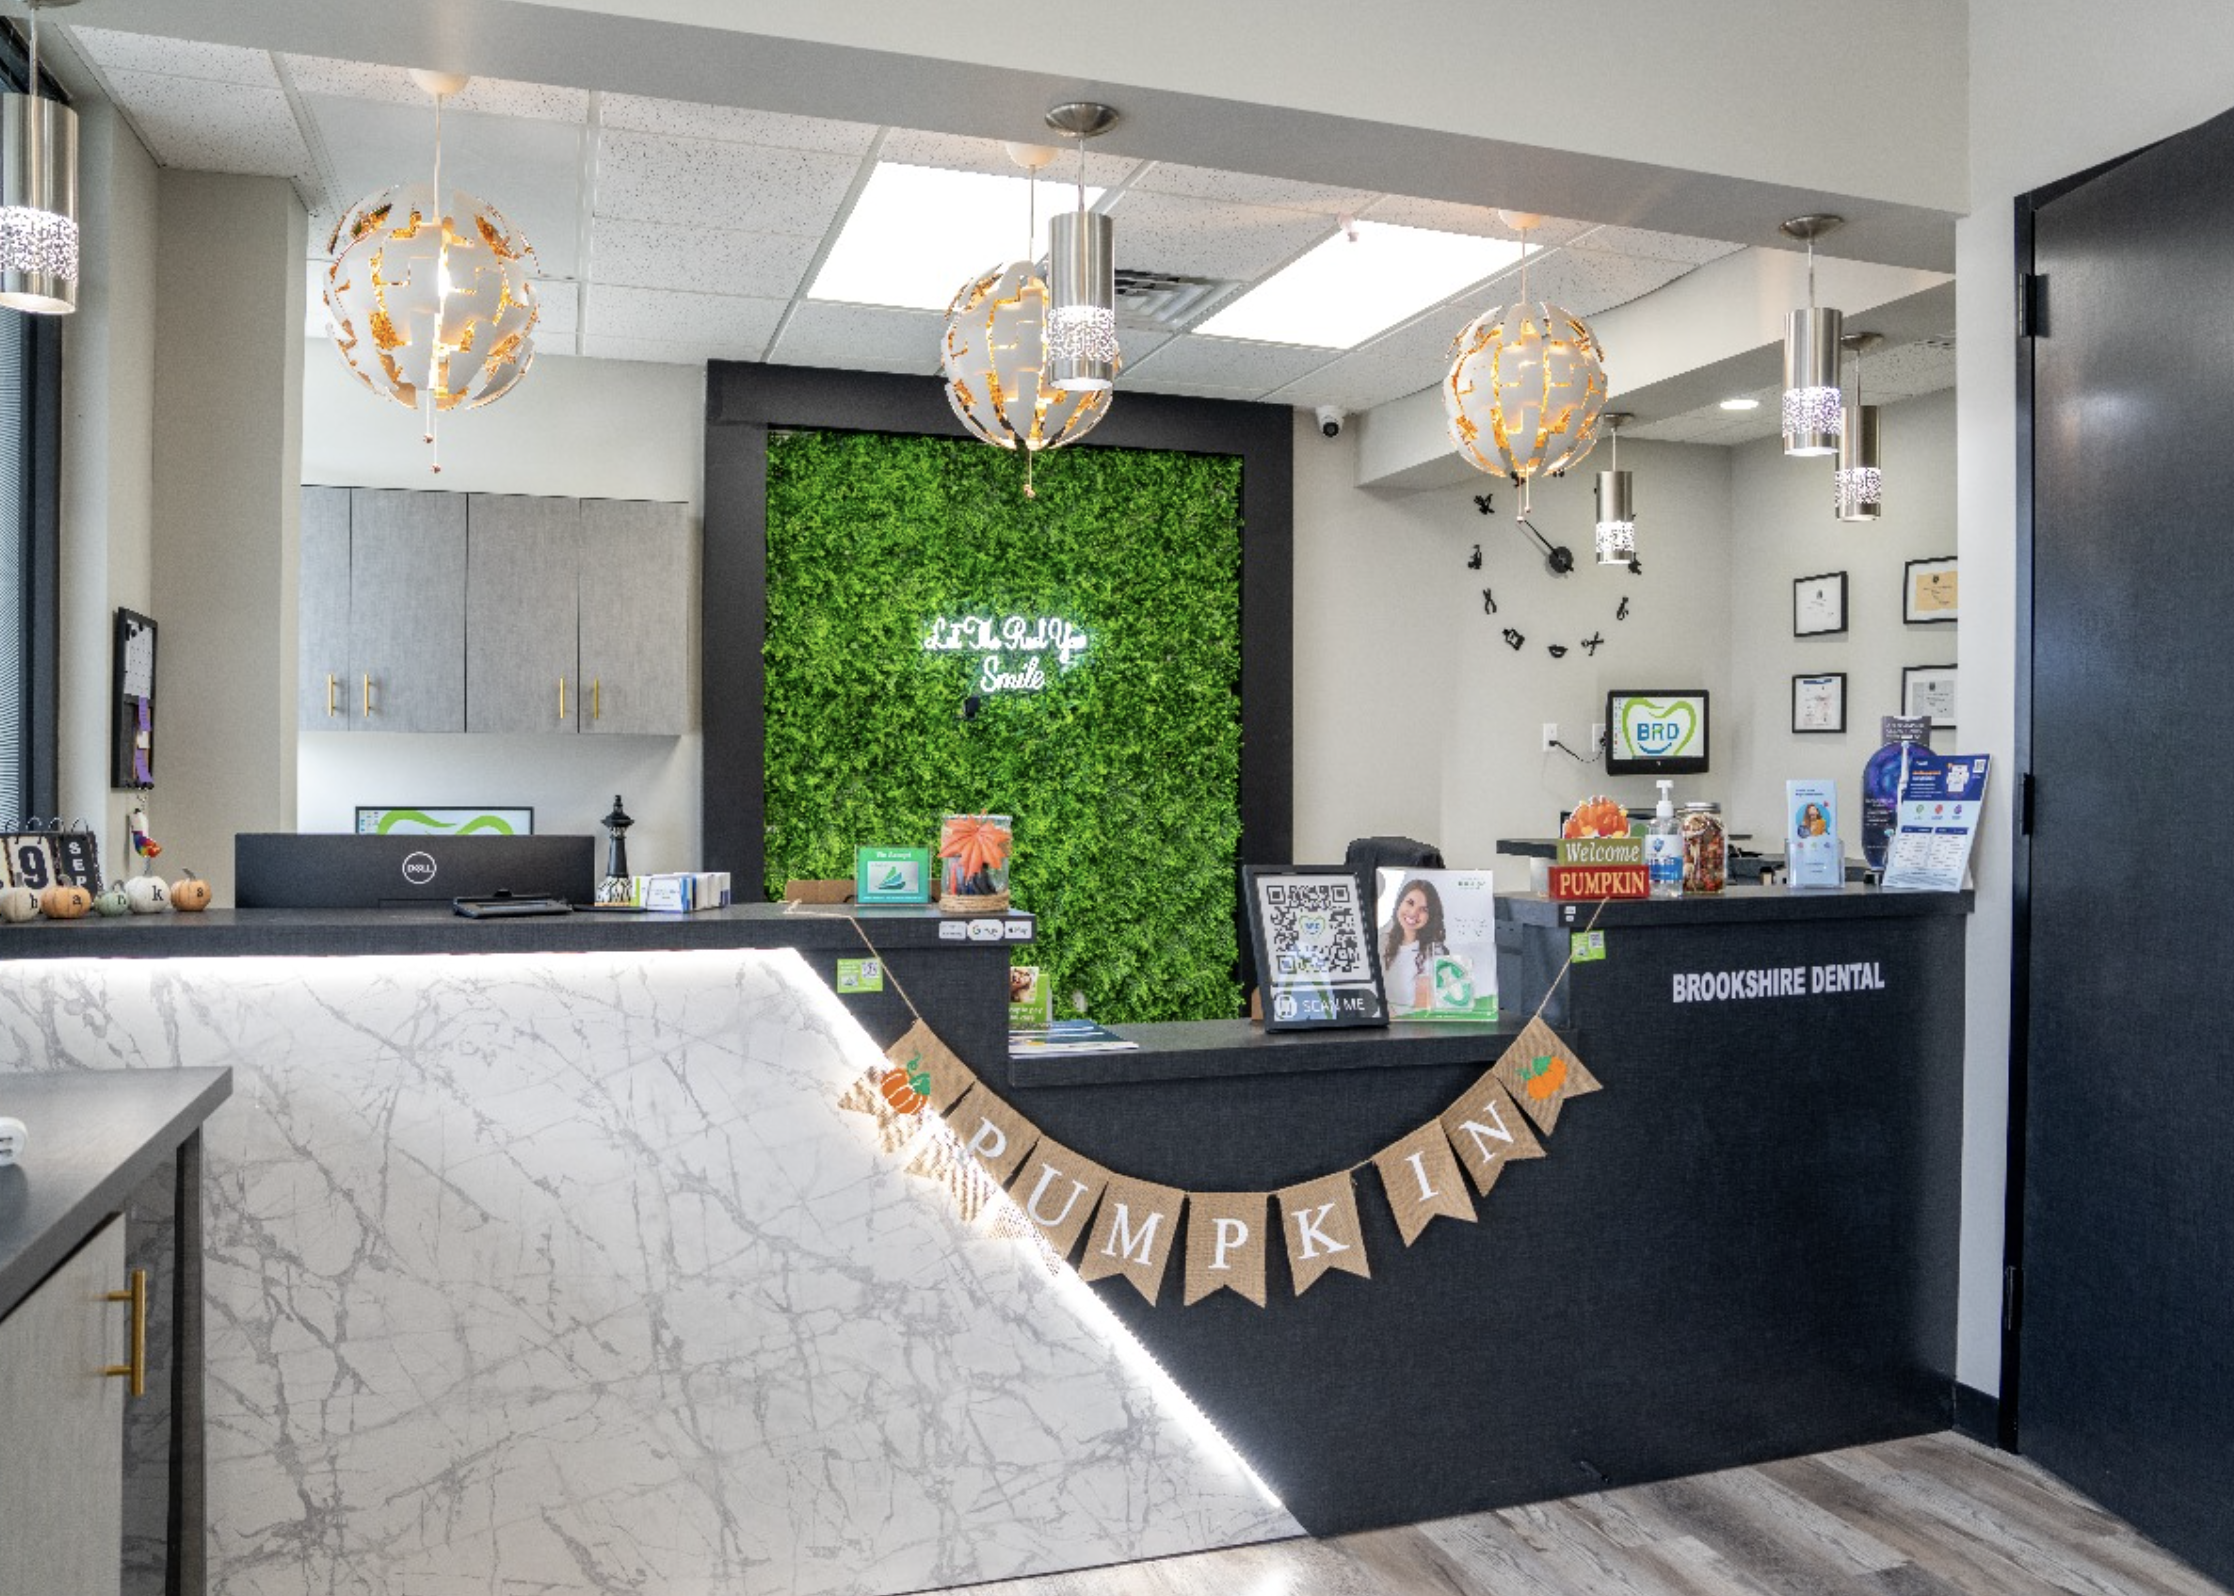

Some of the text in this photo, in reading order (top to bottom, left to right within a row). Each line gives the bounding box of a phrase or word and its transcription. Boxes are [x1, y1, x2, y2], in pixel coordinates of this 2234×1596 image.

[981, 655, 1045, 692] Smile
[1637, 723, 1680, 741] BRD
[1566, 842, 1641, 862] Welcome
[407, 864, 435, 873] DELL
[1560, 871, 1645, 896] PUMPKIN
[1672, 962, 1885, 1004] BROOKSHIRE DENTAL
[1303, 997, 1366, 1013] SCAN ME
[958, 1102, 1516, 1270] PUMPKIN
